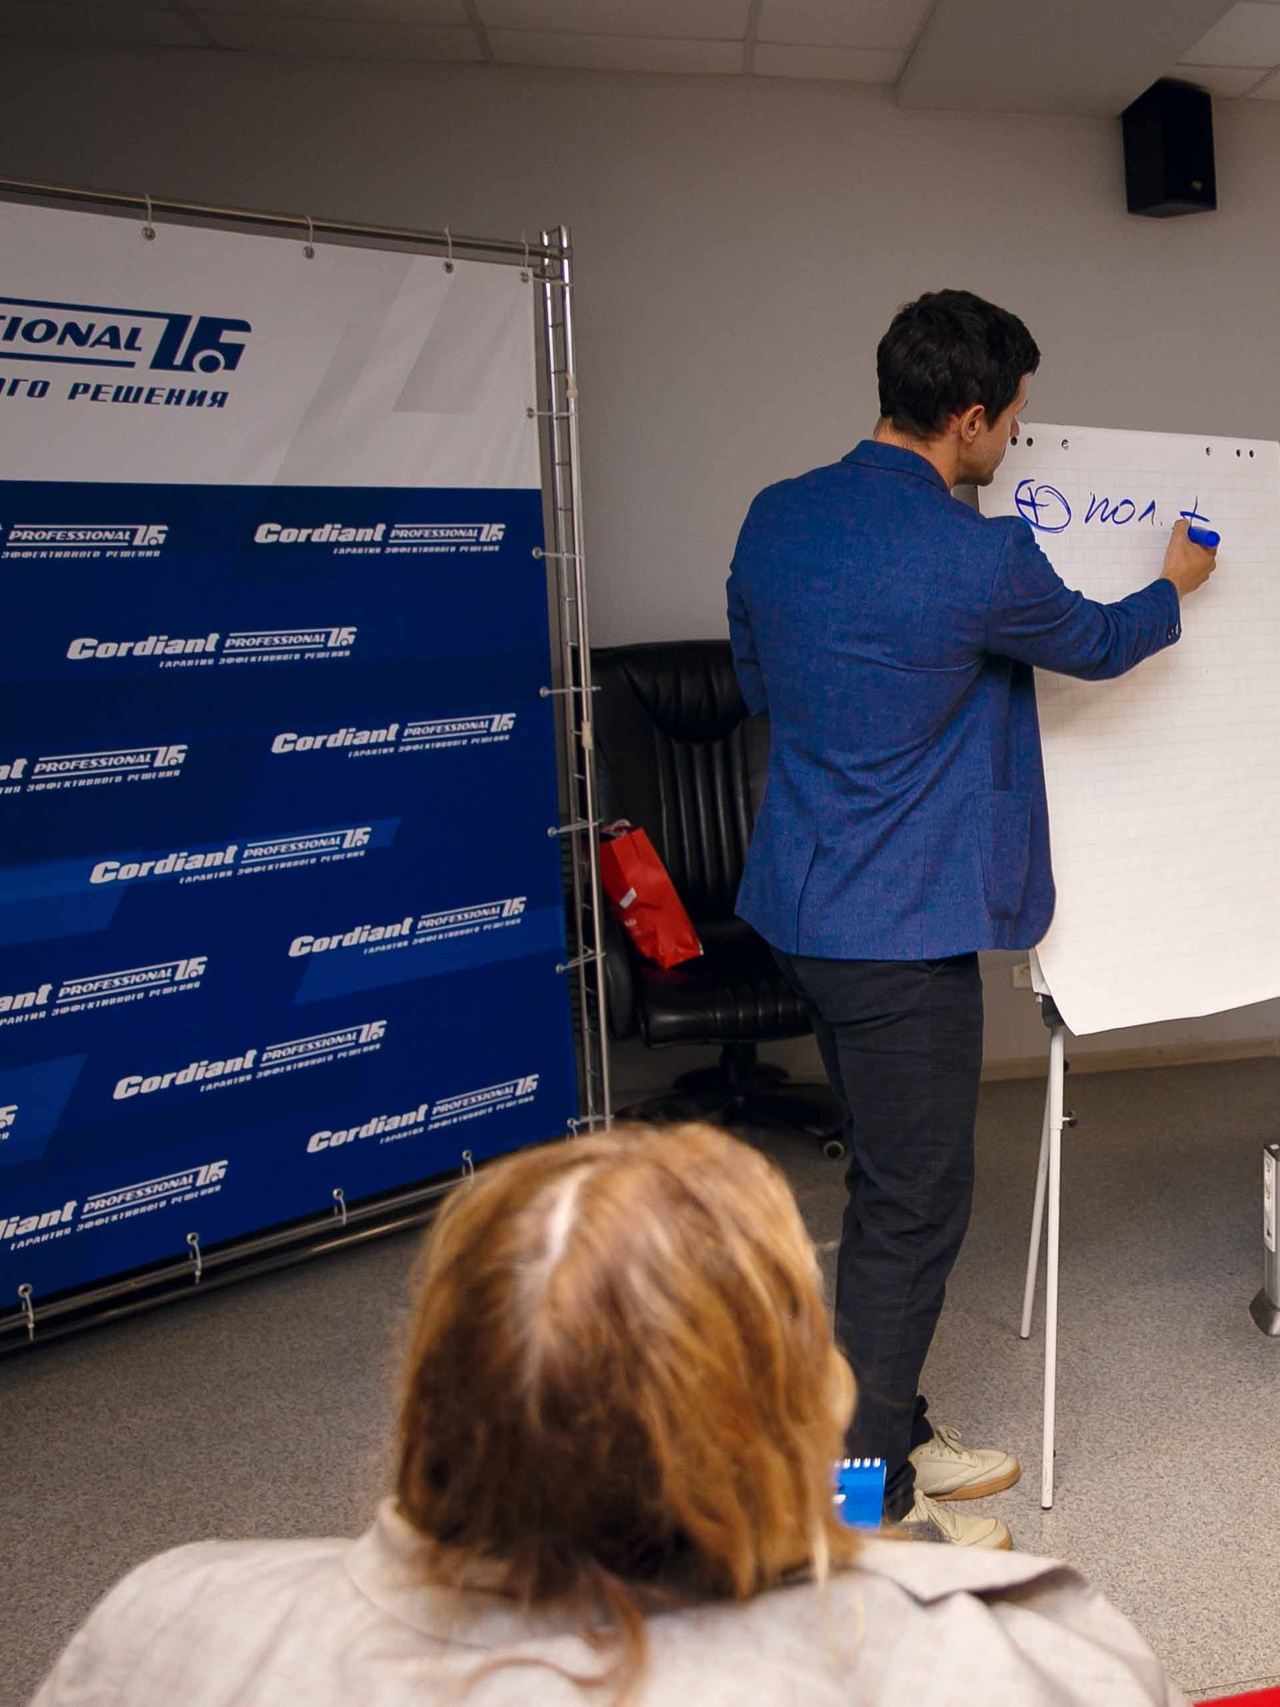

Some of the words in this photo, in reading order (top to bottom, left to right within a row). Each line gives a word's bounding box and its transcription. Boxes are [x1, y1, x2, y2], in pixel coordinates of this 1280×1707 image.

[0, 315, 142, 352] IONAL
[67, 382, 229, 409] РЕШЕНИЯ
[8, 530, 131, 541] PROFESSIONAL
[254, 523, 386, 544] Cordiant
[390, 528, 478, 539] PROFESSIONAL
[66, 633, 220, 660] Cordiant
[225, 633, 325, 648] PROFESSIONAL
[271, 723, 399, 754] Cordiant
[403, 720, 489, 737] PROFESSIONAL
[33, 753, 152, 774] PROFESSIONAL
[89, 844, 238, 884] Cordiant
[242, 836, 340, 858] PROFESSIONAL
[288, 917, 413, 957] Cordiant
[417, 906, 500, 930] PROFESSIONAL
[58, 968, 172, 998] PROFESSIONAL
[113, 1049, 257, 1100] Cordiant
[261, 1032, 357, 1062] PROFESSIONAL
[306, 1103, 428, 1153] Cordiant
[432, 1086, 514, 1115] PROFESSIONAL
[82, 1174, 194, 1213] PROFESSIONAL
